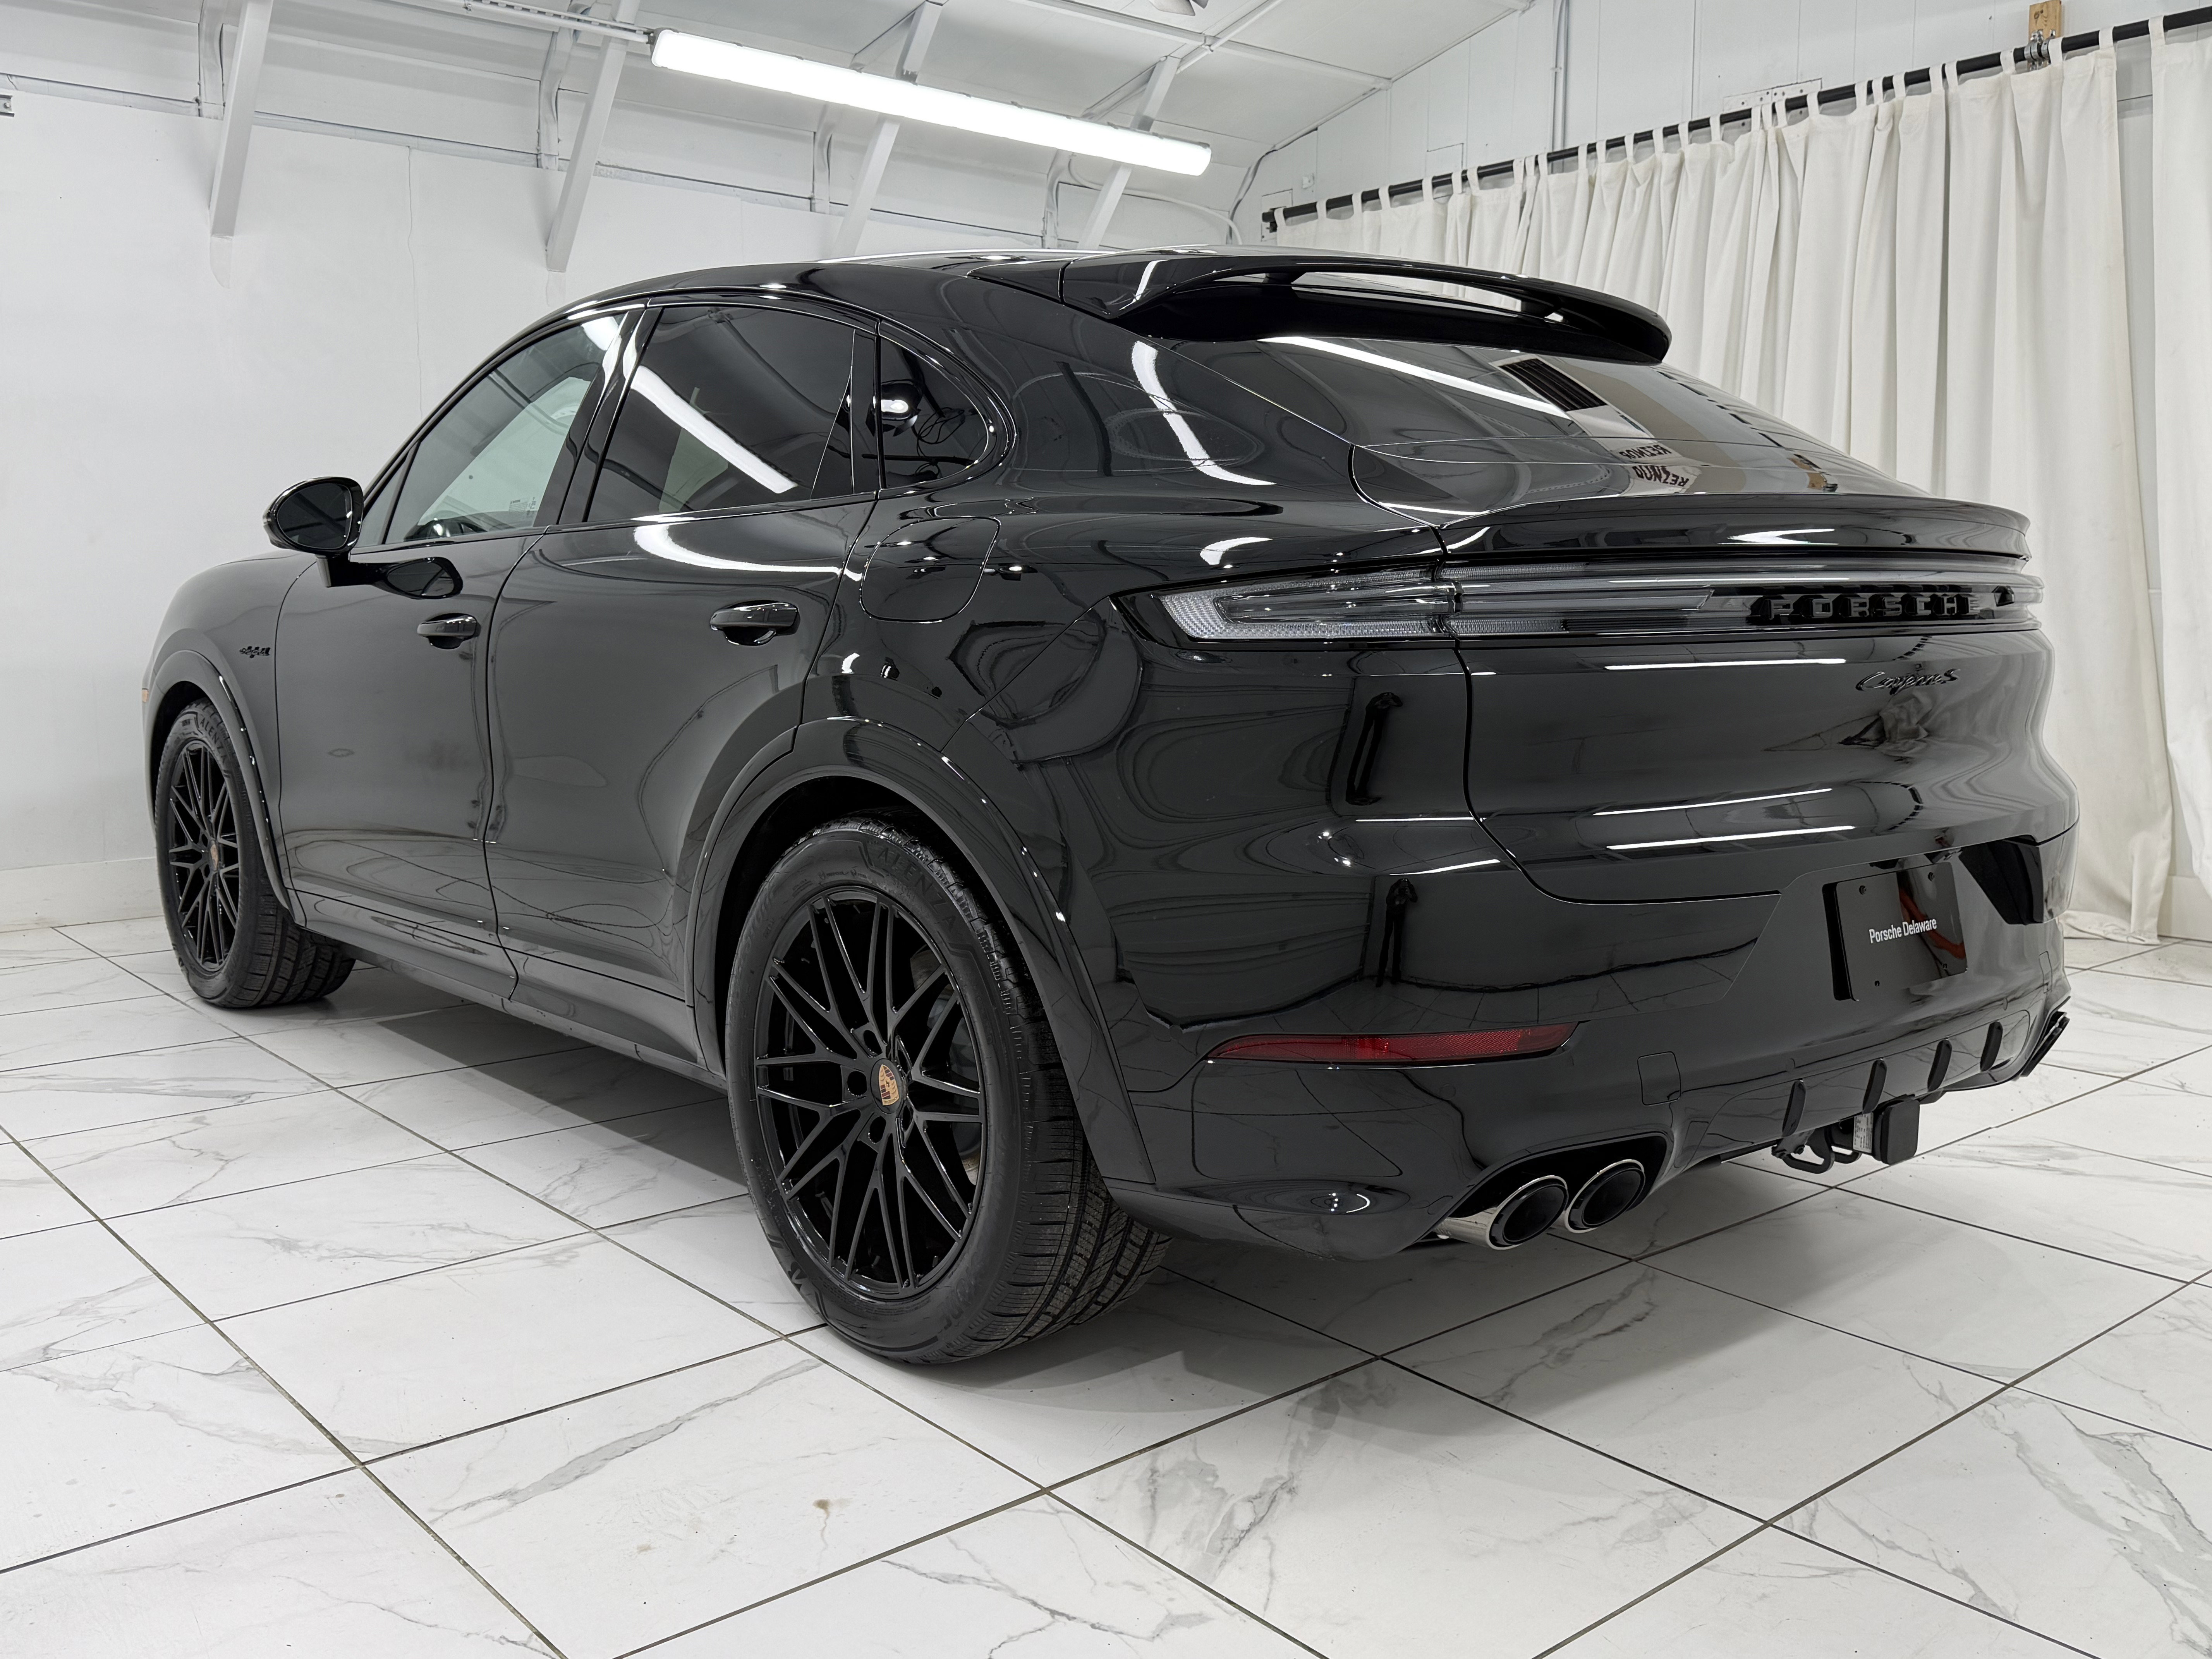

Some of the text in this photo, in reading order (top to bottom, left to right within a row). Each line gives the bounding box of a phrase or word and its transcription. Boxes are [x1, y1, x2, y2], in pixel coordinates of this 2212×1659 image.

[1767, 595, 1979, 619] PORSCHE
[1869, 918, 1937, 943] Porsche Delaware
